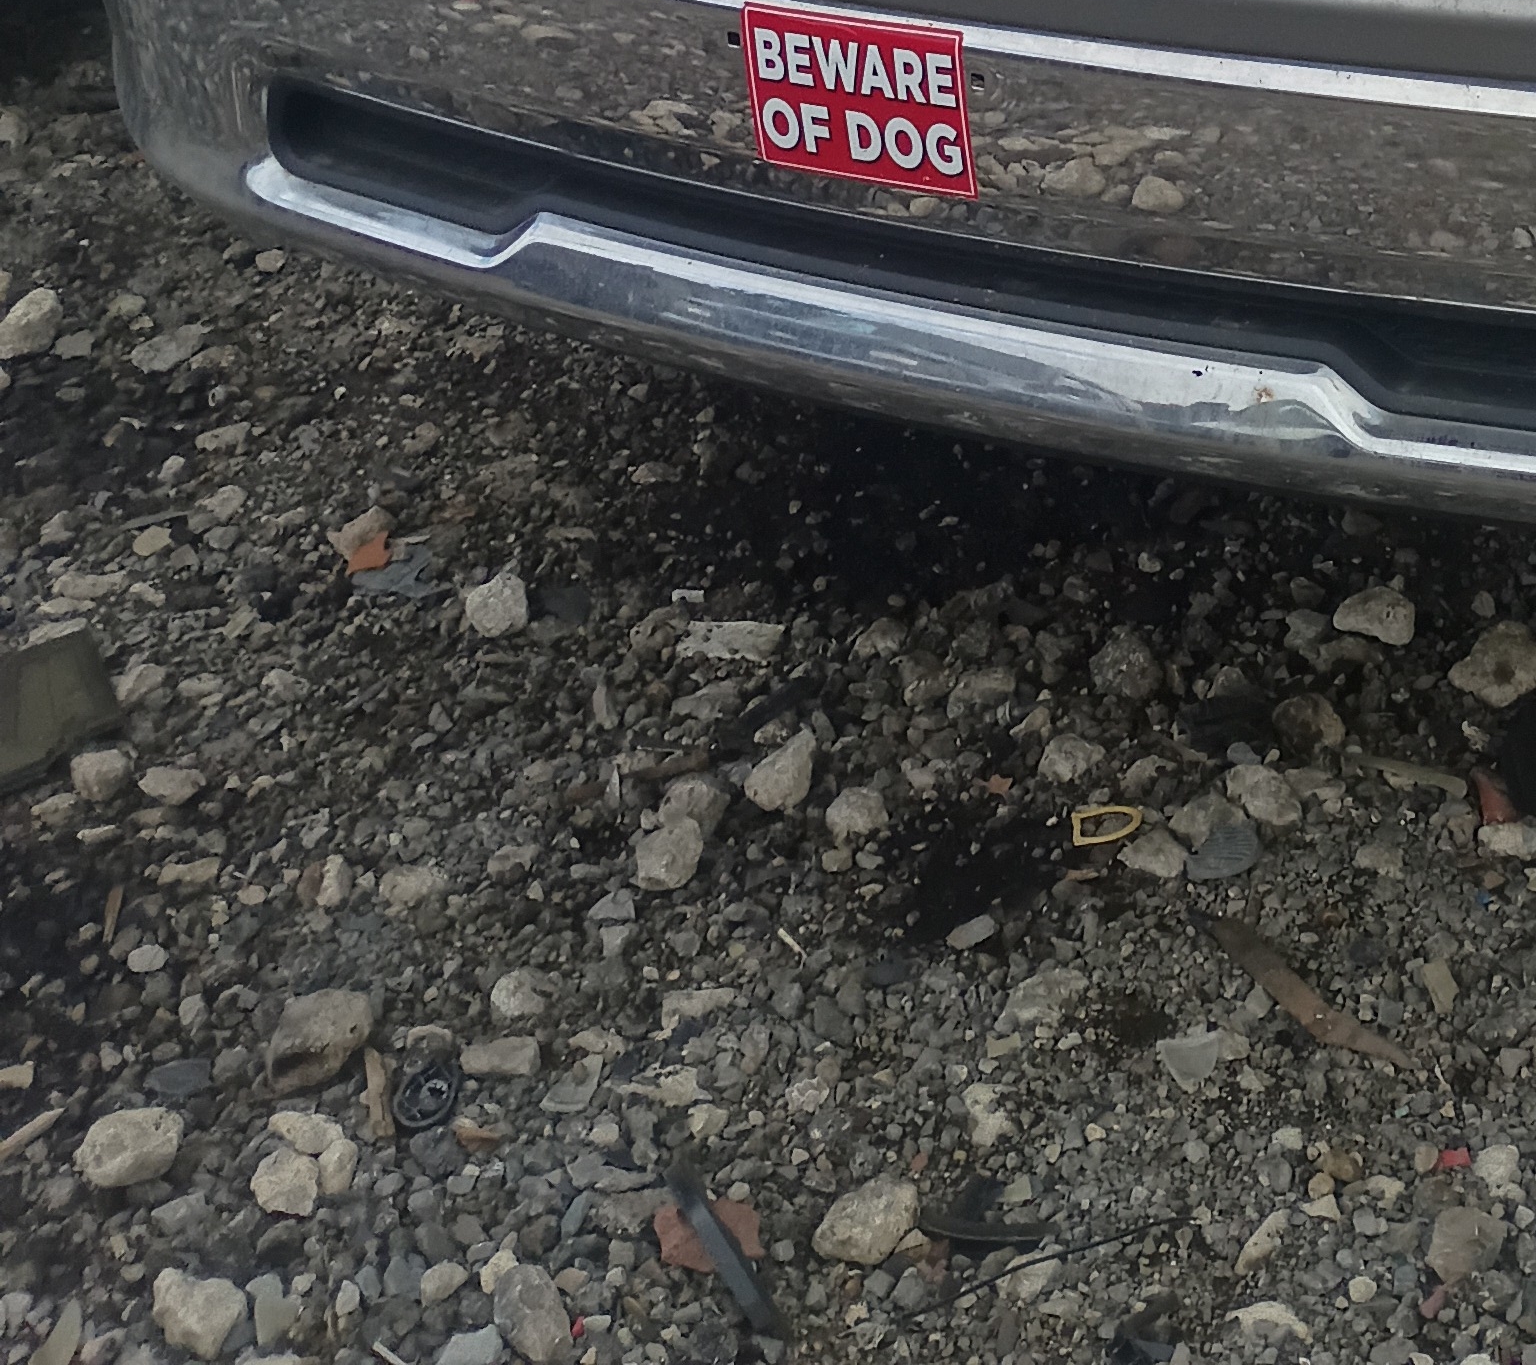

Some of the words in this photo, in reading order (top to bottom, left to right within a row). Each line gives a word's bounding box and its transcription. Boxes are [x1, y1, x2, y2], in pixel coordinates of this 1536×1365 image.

[754, 27, 957, 108] BEWARE
[762, 97, 831, 154] OF
[845, 109, 964, 176] DOG
